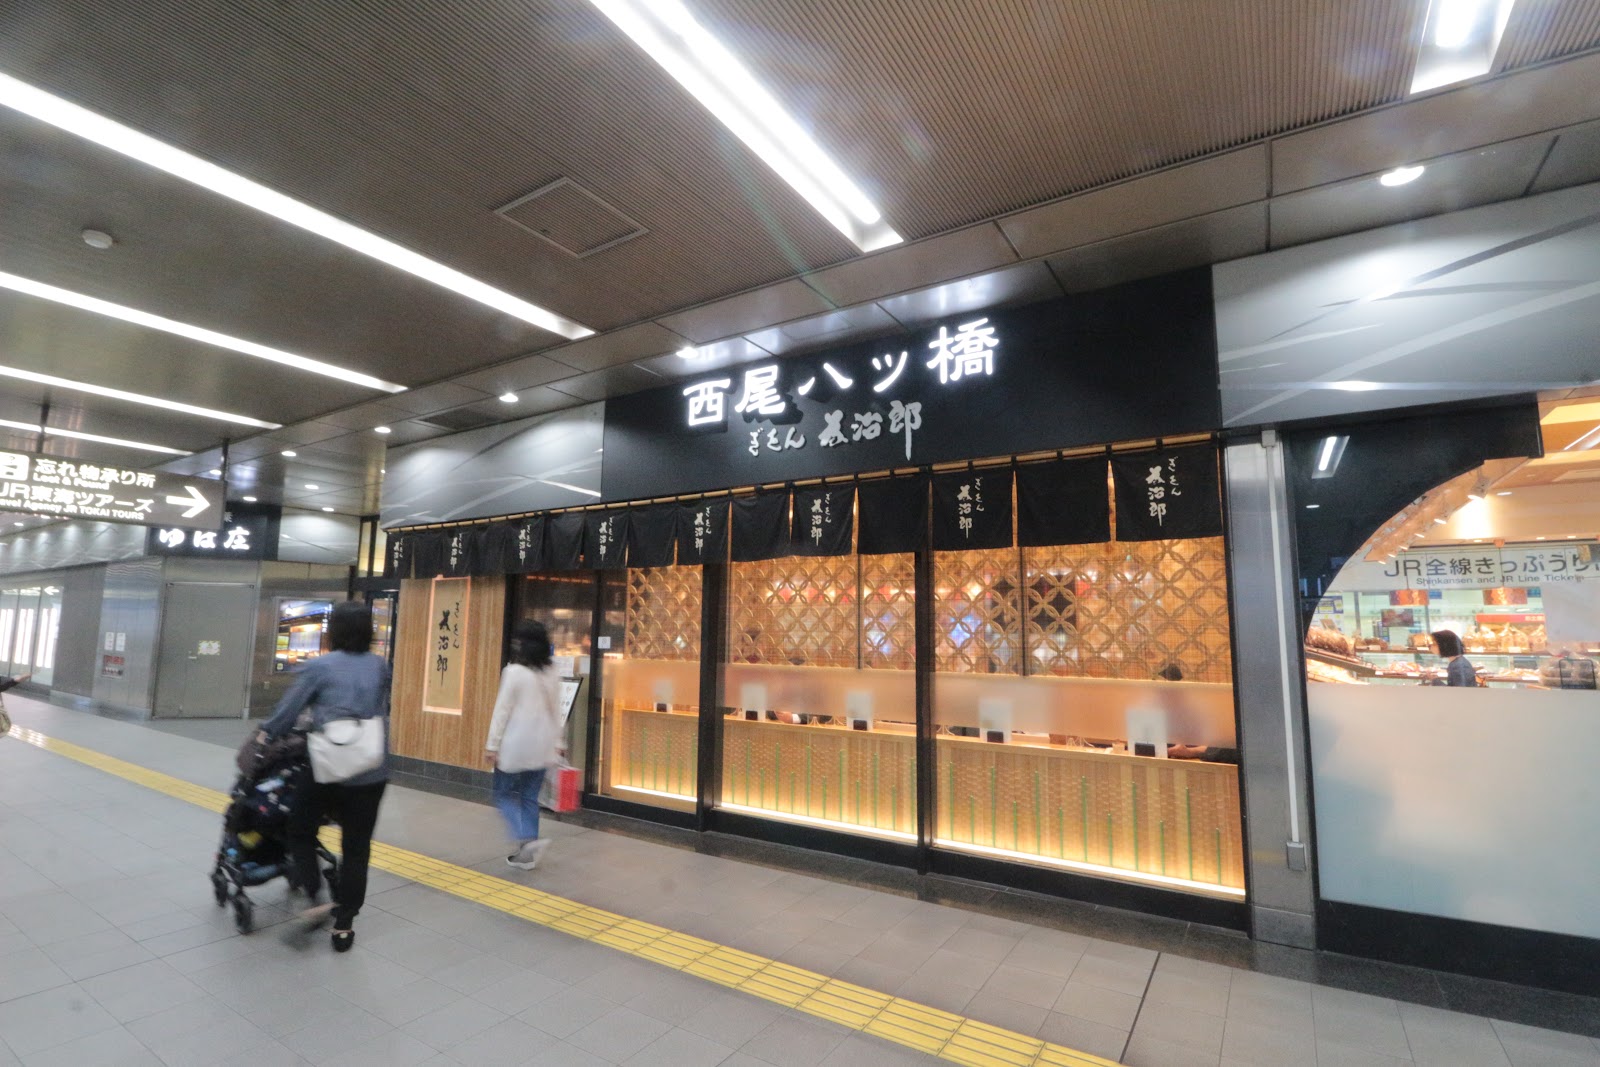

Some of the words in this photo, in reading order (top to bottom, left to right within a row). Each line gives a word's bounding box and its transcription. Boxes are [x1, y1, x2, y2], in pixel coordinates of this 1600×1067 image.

[33, 472, 60, 484] Lost
[74, 477, 110, 490] Found
[34, 458, 156, 488] 忘れ物承り所
[0, 481, 154, 513] JR東海ツアーズ
[23, 499, 62, 513] Agency
[63, 504, 78, 514] JR
[80, 506, 110, 517] TOKAI
[112, 509, 144, 521] TOURS
[1416, 577, 1473, 586] Shinkansen
[1477, 576, 1495, 584] and
[1500, 575, 1514, 583] JR
[1518, 575, 1540, 583] Line
